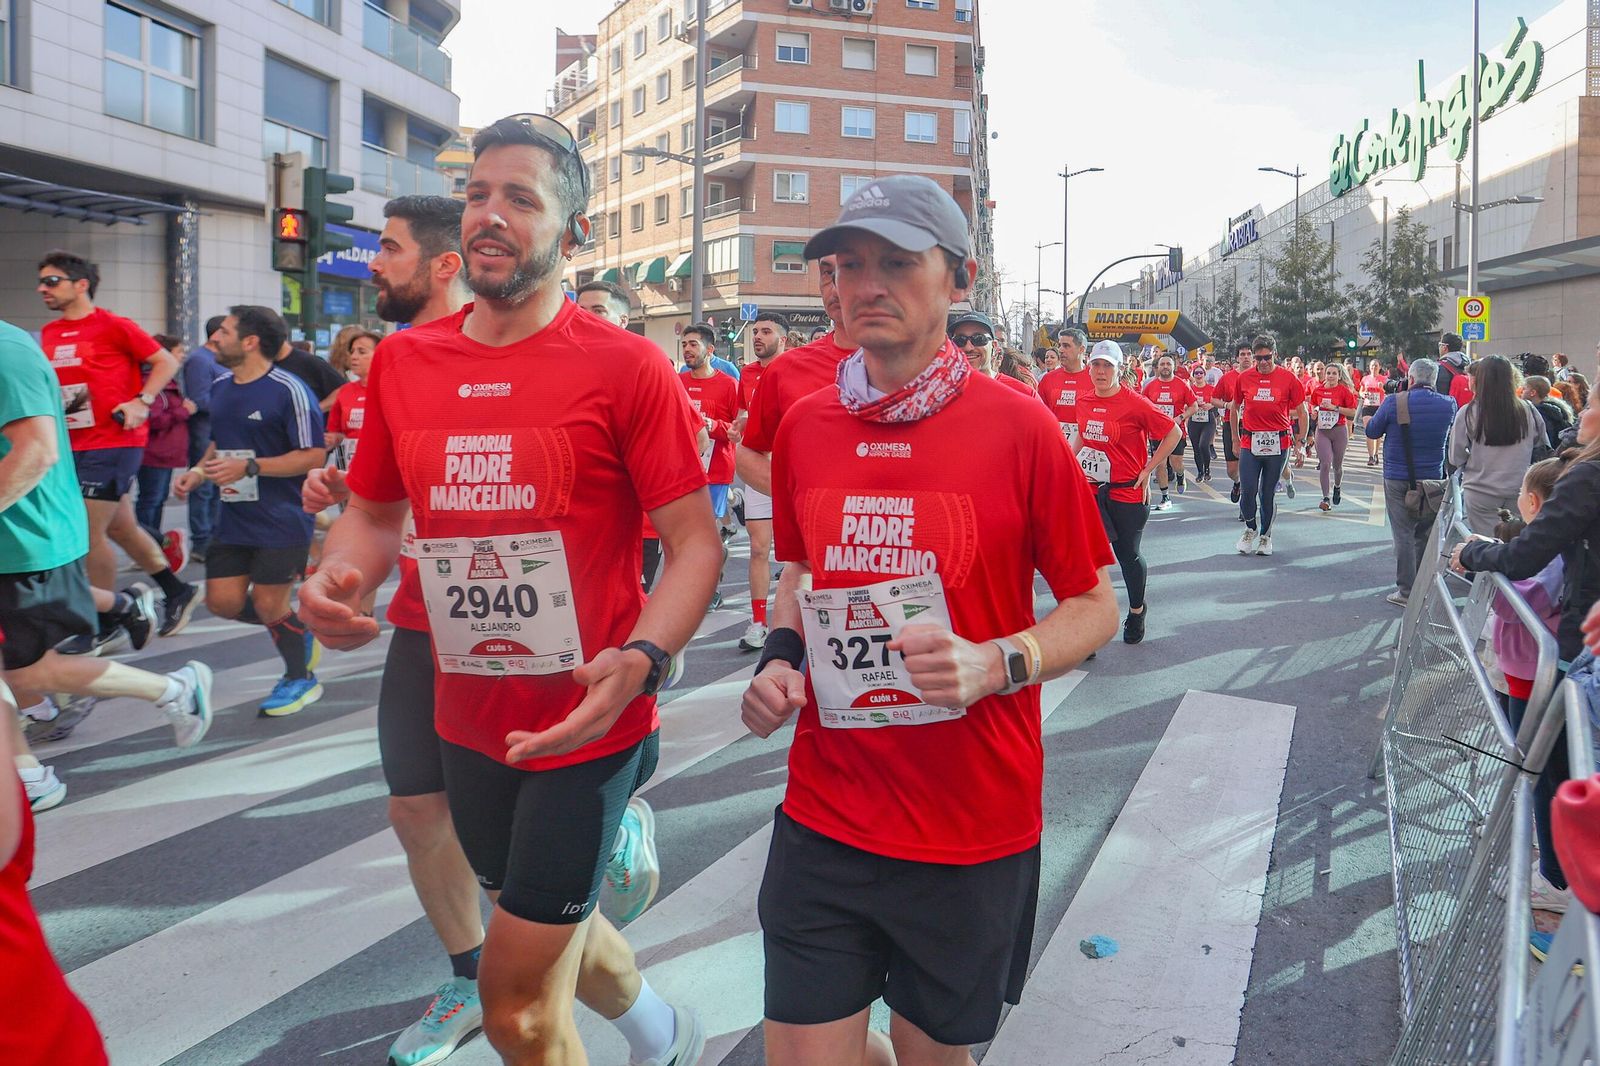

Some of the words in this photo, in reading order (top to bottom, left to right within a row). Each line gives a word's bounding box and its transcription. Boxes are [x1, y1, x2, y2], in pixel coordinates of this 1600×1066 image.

[1351, 118, 1411, 185] Corte
[848, 199, 890, 211] adidas
[1467, 304, 1480, 312] 30
[1094, 312, 1168, 325] MARCELINO
[473, 383, 512, 391] OXIMESA
[445, 435, 512, 453] MEMORIAL
[869, 442, 912, 451] OXIMESA
[445, 454, 512, 483] PADRE
[1081, 459, 1098, 473] 611
[430, 484, 536, 511] MARCELINO
[842, 495, 914, 516] MEMORIAL
[841, 515, 915, 547] PADRE
[520, 537, 553, 547] OXIMESA
[824, 545, 937, 576] MARCELINO
[900, 580, 932, 591] OXIMESA
[446, 583, 539, 620] 2940
[848, 594, 871, 603] POPULAR
[852, 608, 875, 620] PADRE
[470, 622, 522, 632] ALEJANDRO
[848, 617, 884, 630] MARCELINO
[486, 643, 507, 652] CAJÓN
[827, 633, 906, 671] 327
[861, 670, 898, 683] RAFAEL
[869, 693, 891, 703] CAJÓN
[893, 694, 898, 702] 5
[892, 710, 911, 721] eig
